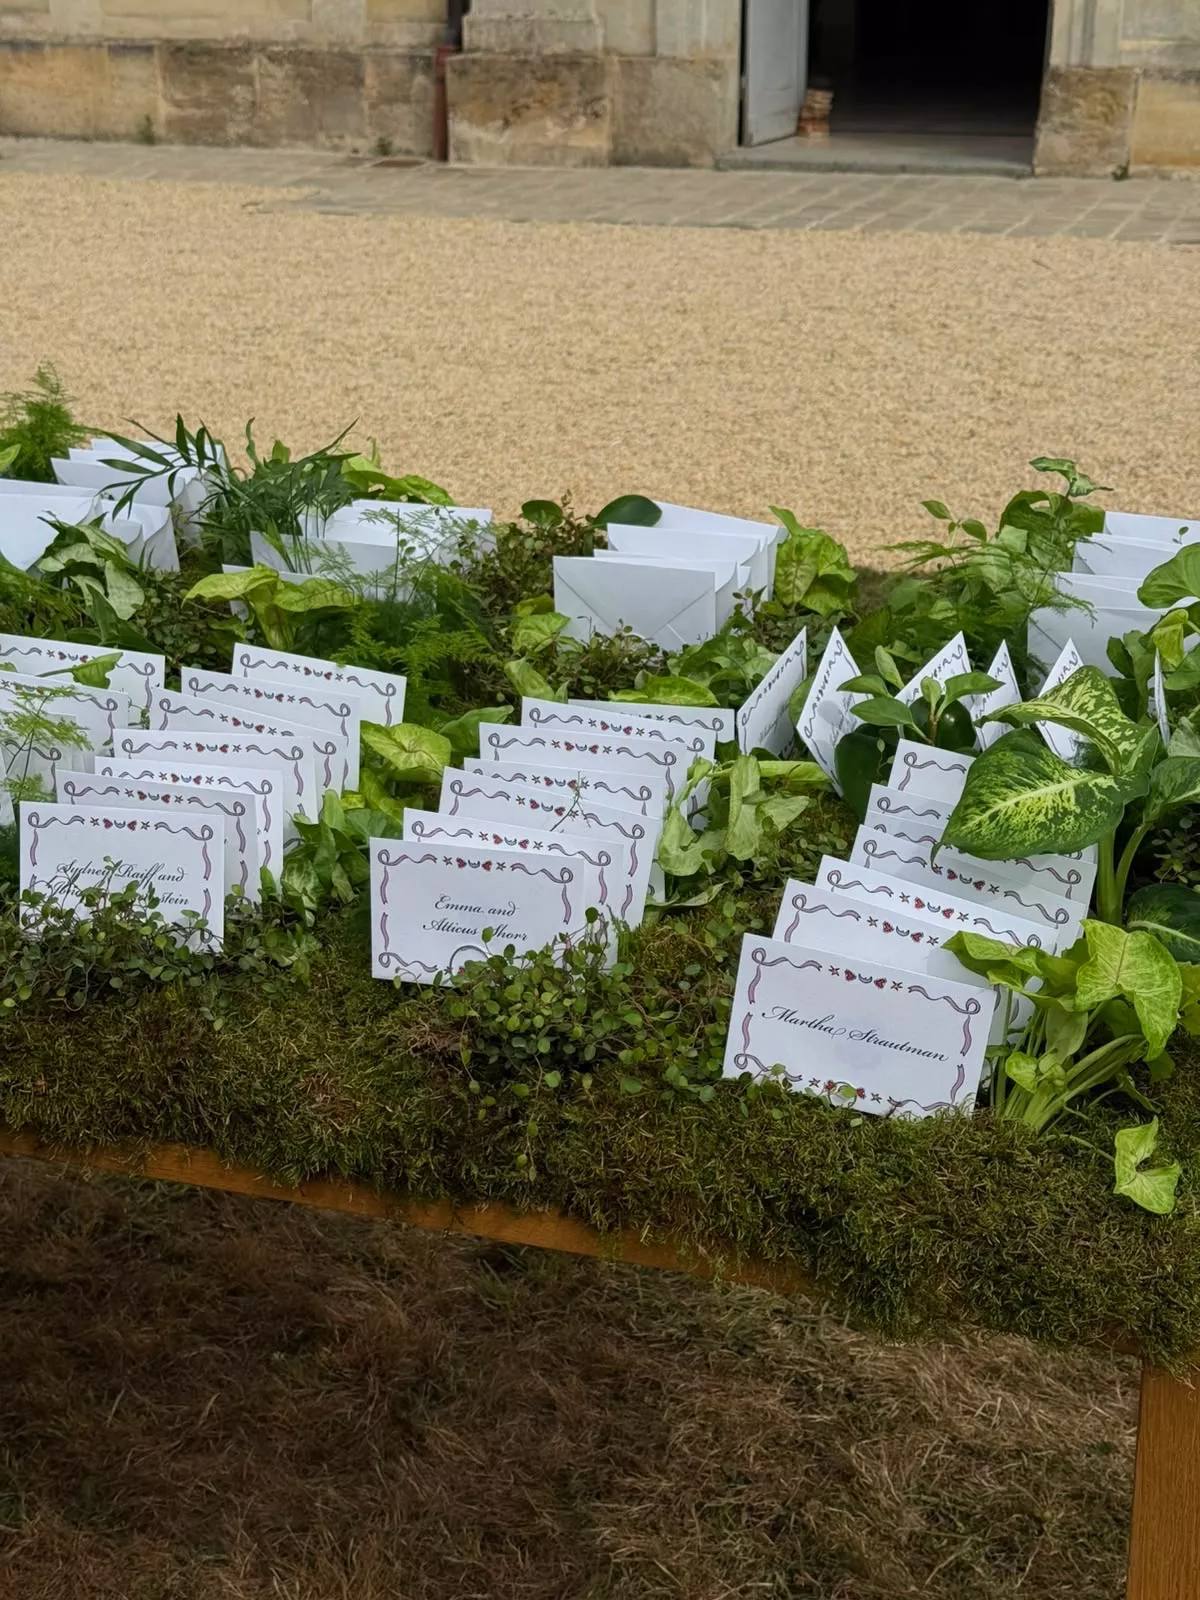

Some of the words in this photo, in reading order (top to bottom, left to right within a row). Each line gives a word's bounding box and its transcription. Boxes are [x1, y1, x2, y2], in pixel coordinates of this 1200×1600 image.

[57, 859, 112, 888] Sydney
[158, 867, 188, 882] and
[435, 894, 484, 914] Emma
[488, 901, 519, 916] and
[423, 918, 479, 936] Atticus
[761, 1005, 846, 1038] Martha
[847, 1028, 949, 1062] Strautman
